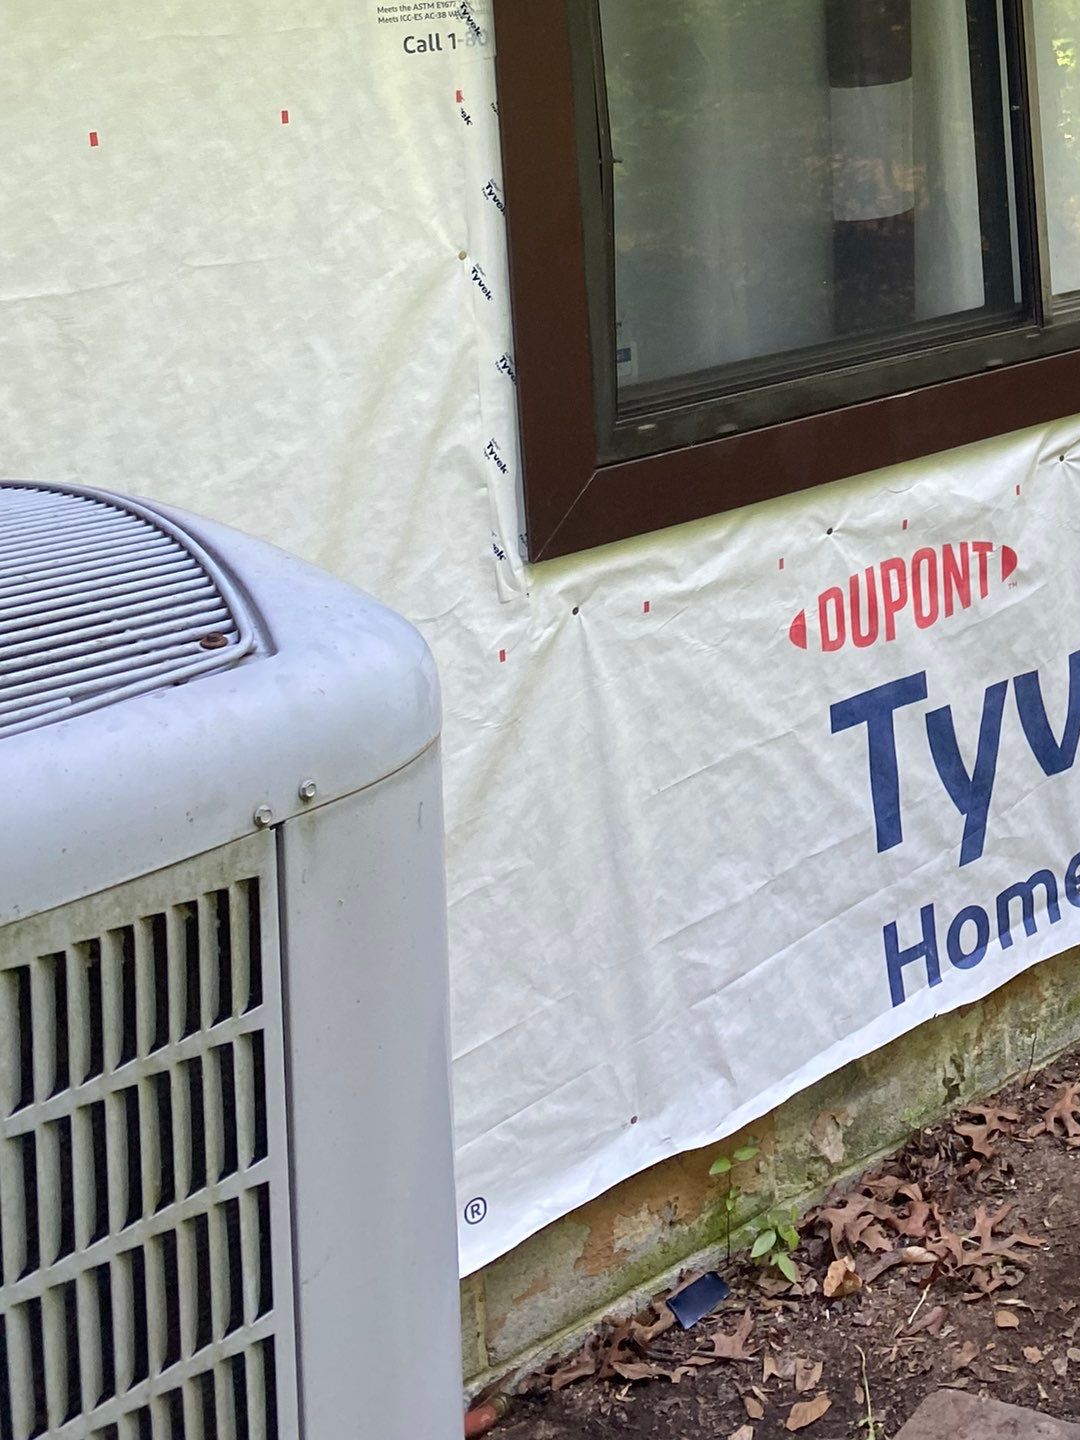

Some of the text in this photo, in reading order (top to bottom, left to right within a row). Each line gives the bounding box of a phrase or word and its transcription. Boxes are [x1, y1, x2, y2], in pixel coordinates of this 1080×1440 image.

[403, 33, 443, 54] Call
[487, 440, 508, 474] Tyvek
[818, 541, 993, 652] DUPONT
